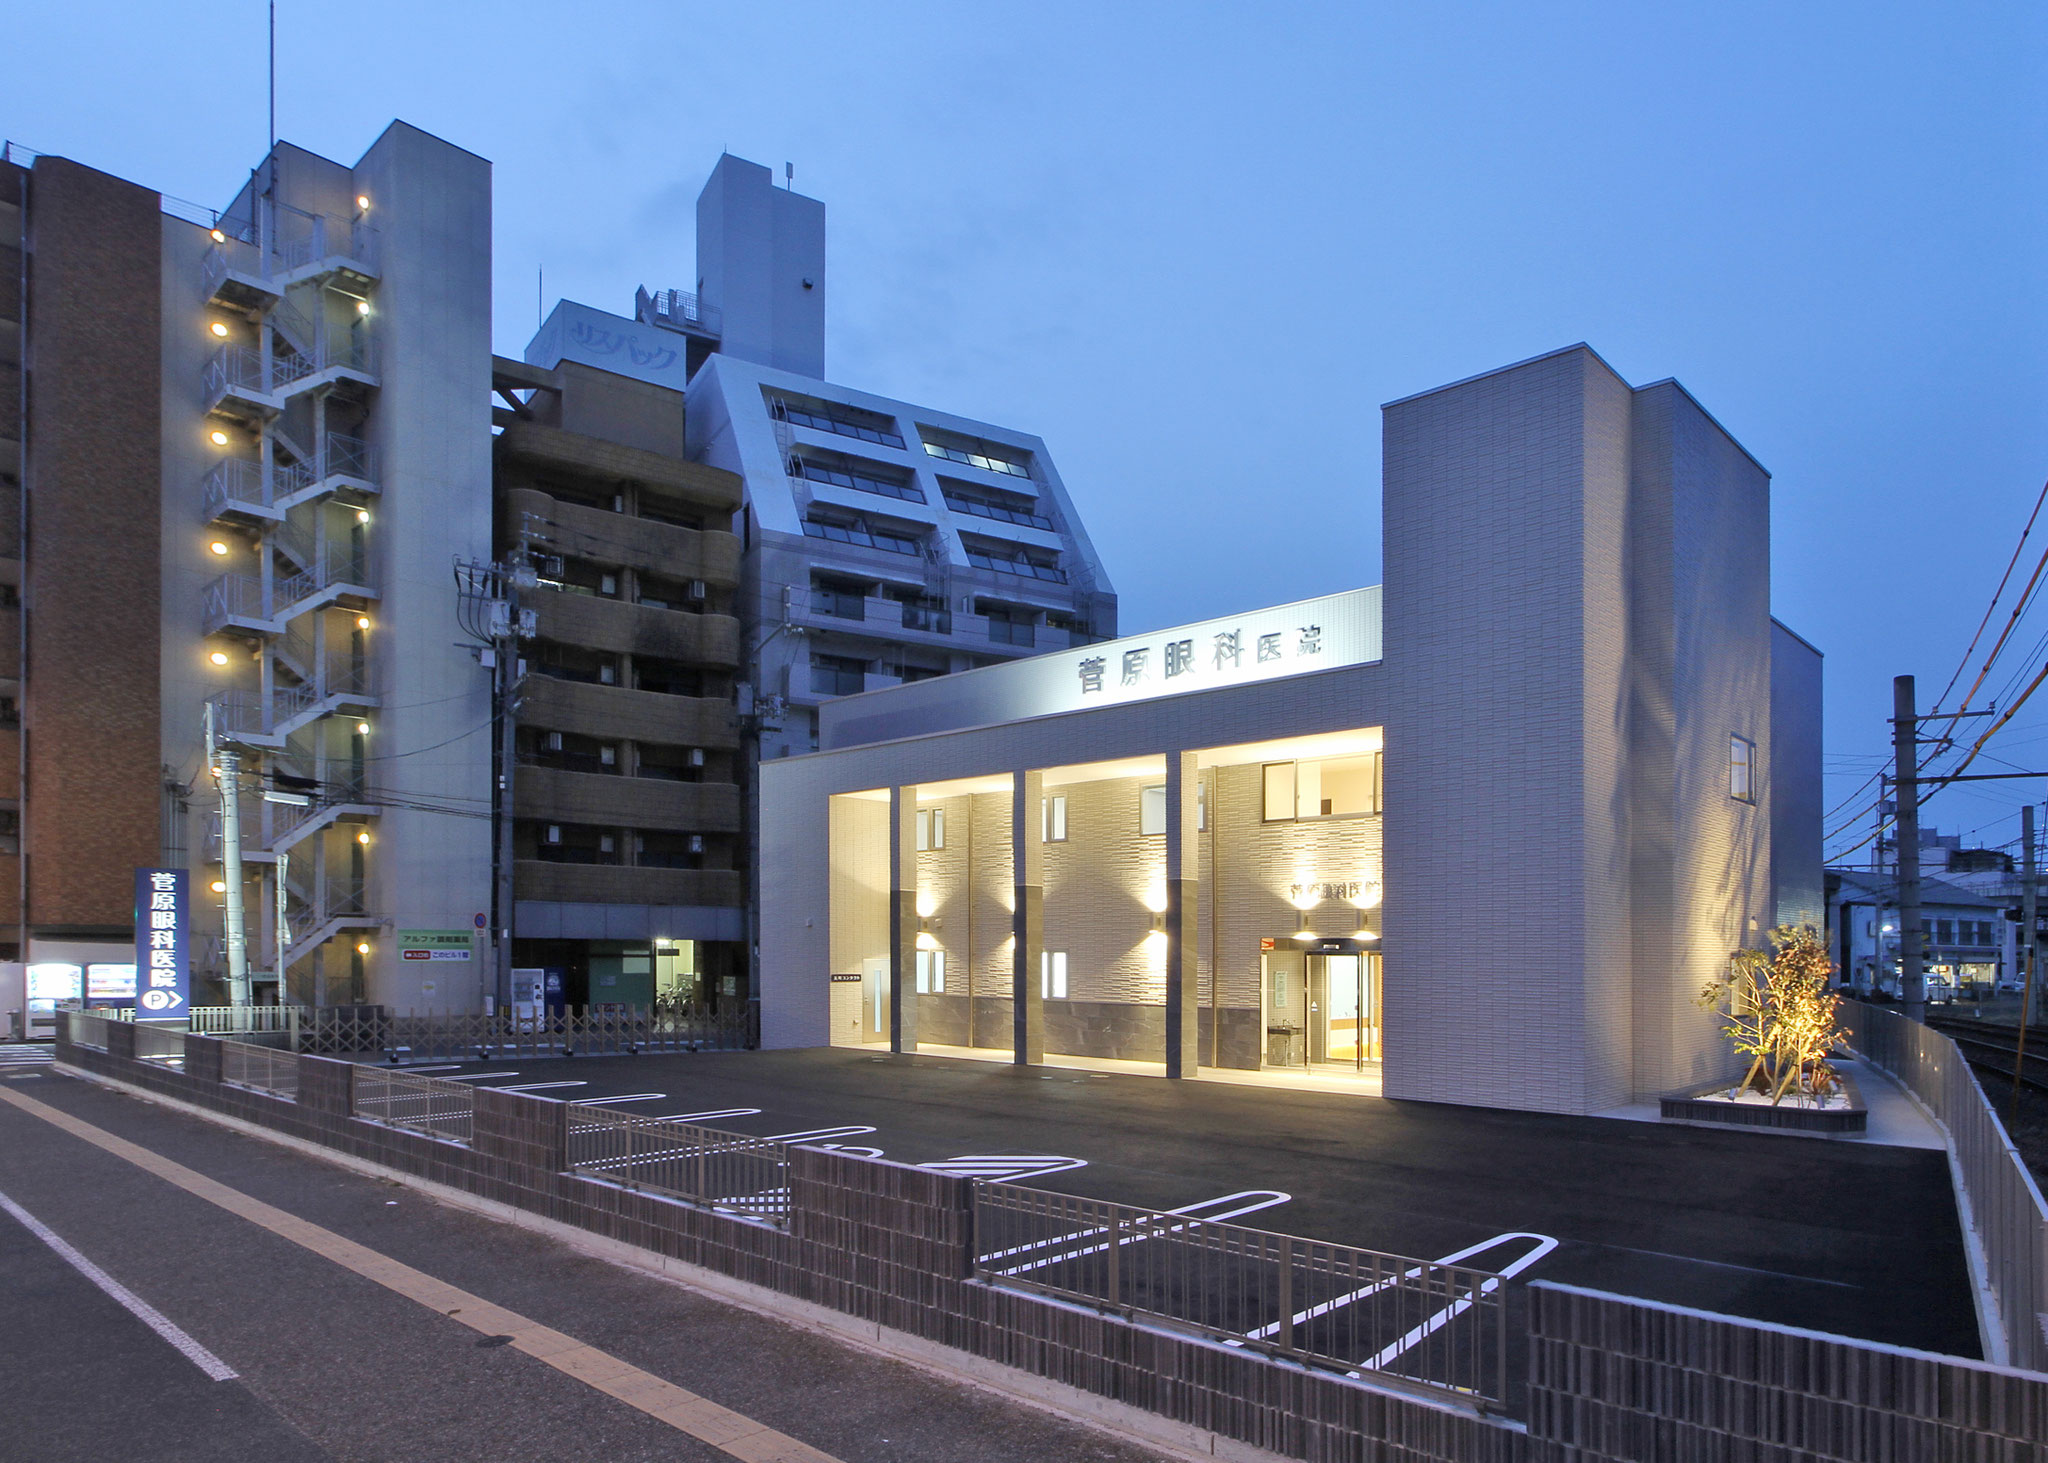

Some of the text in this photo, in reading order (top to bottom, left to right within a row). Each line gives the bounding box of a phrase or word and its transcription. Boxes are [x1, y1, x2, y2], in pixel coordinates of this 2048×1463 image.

[1078, 624, 1322, 694] 菅原眼科医院
[150, 872, 177, 988] 菅原眼科医院
